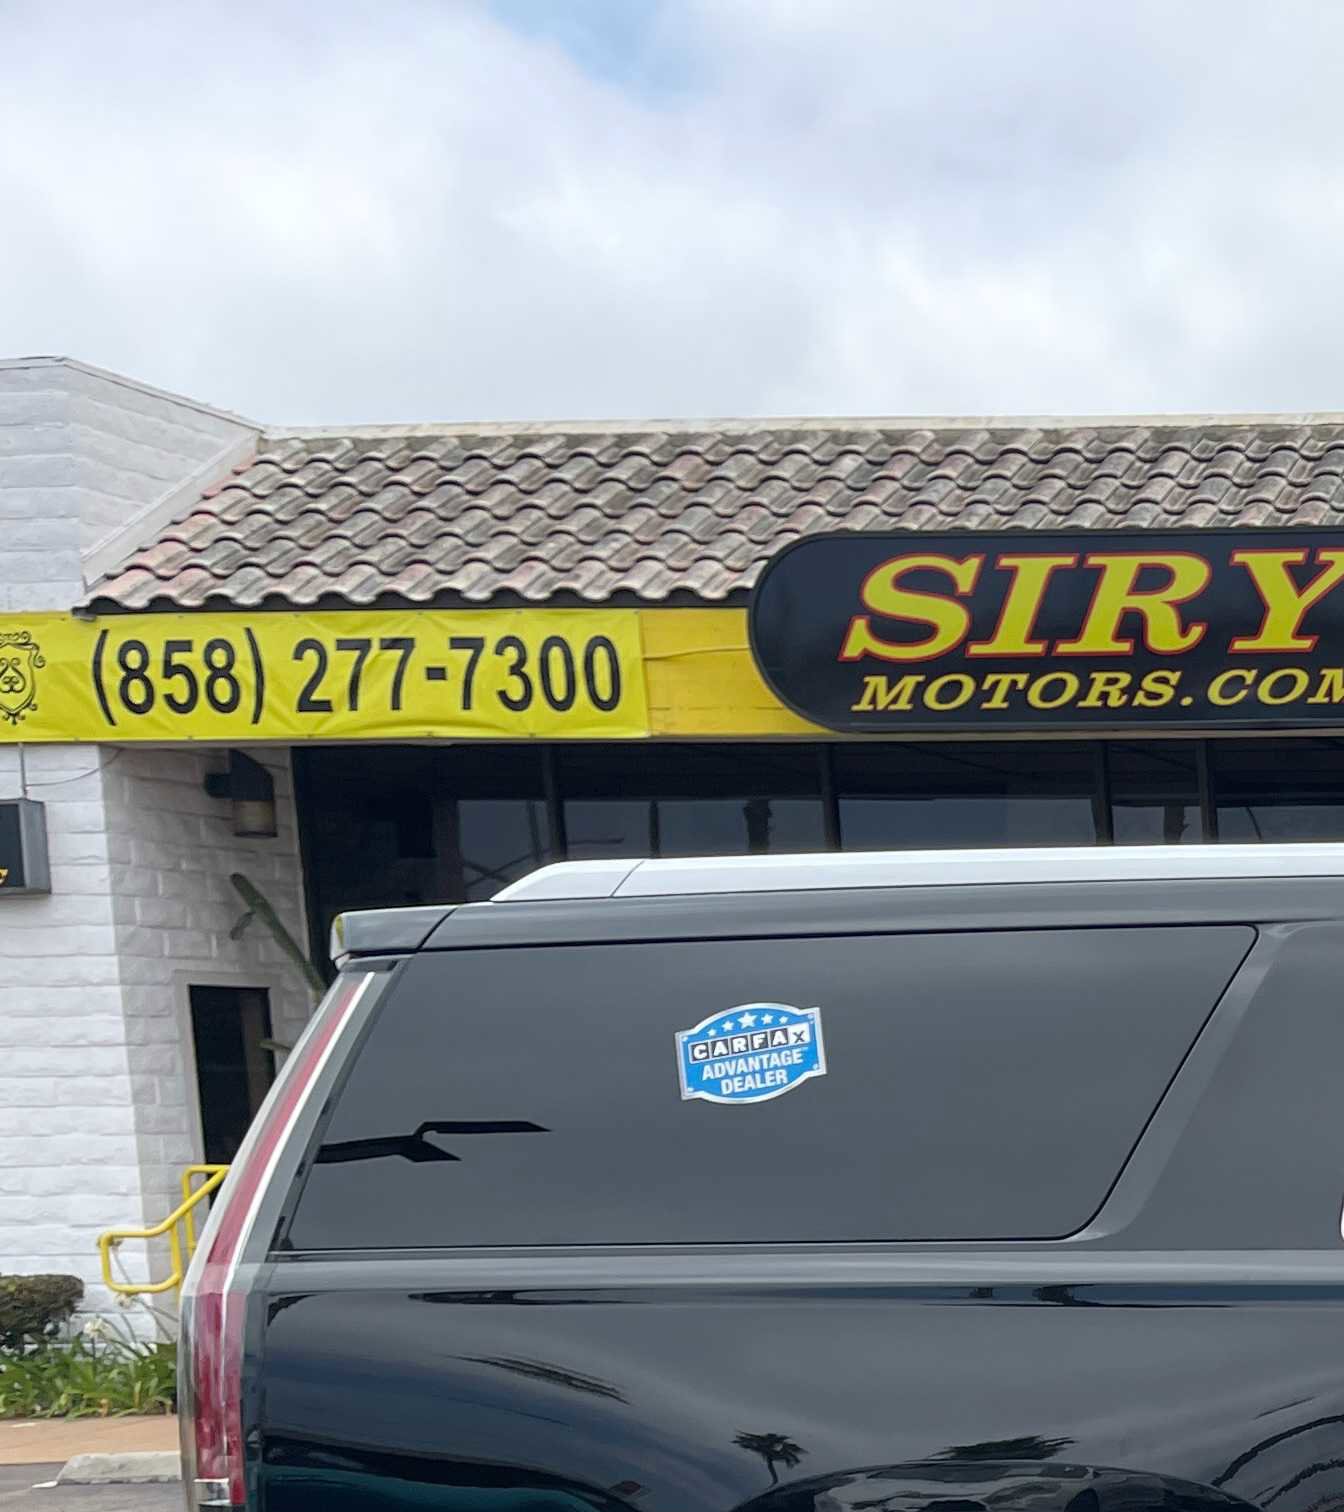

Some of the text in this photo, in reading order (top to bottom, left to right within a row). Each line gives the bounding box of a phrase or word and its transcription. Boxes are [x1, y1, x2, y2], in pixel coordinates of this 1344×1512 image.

[92, 627, 622, 727] (858) 277-7300
[692, 1028, 808, 1062] CARFAX
[702, 1049, 804, 1081] ADVANTAGE
[721, 1069, 789, 1095] DEALER
